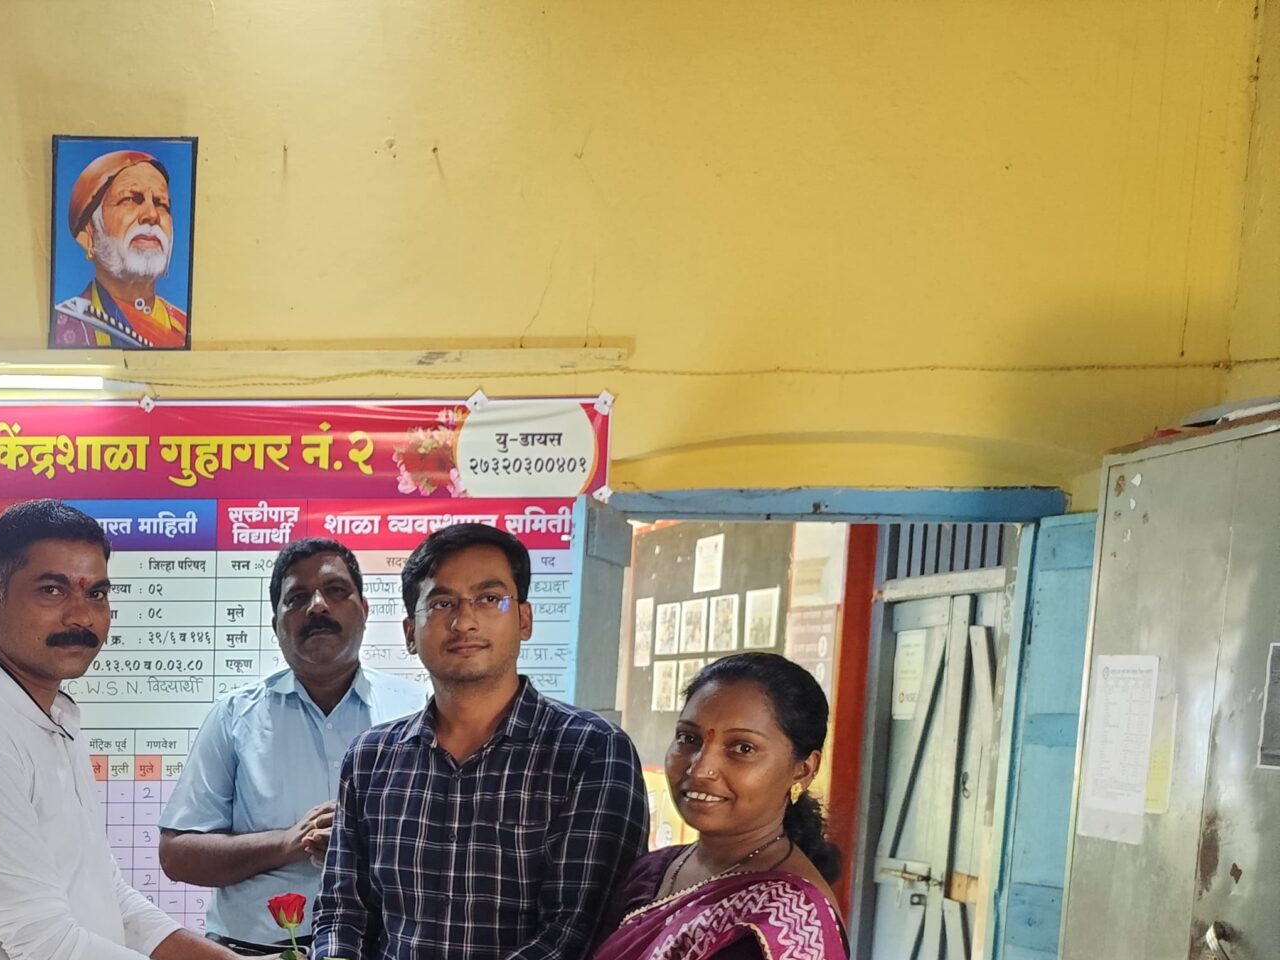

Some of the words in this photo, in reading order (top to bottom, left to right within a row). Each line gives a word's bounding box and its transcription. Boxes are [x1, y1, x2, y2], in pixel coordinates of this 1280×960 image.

[495, 431, 562, 453] यु-डायस
[161, 425, 290, 487] गुहागर
[301, 421, 374, 477] नं.२
[468, 455, 587, 477] २७३२०३००४०१
[138, 510, 198, 538] माहिती
[323, 514, 381, 535] शाळा
[504, 506, 572, 537] समिती
[232, 521, 293, 544] विद्यार्थी
[148, 556, 175, 572] जिल्हा
[178, 556, 206, 573] परिषद
[231, 559, 251, 571] सन
[541, 556, 555, 567] पद
[227, 604, 245, 623] मुले
[226, 631, 248, 649] मुली
[225, 657, 253, 674] एकूण
[115, 738, 128, 752] पूर्व
[146, 738, 177, 750] गणवेश
[111, 762, 129, 777] मुली
[139, 762, 154, 777] मुले
